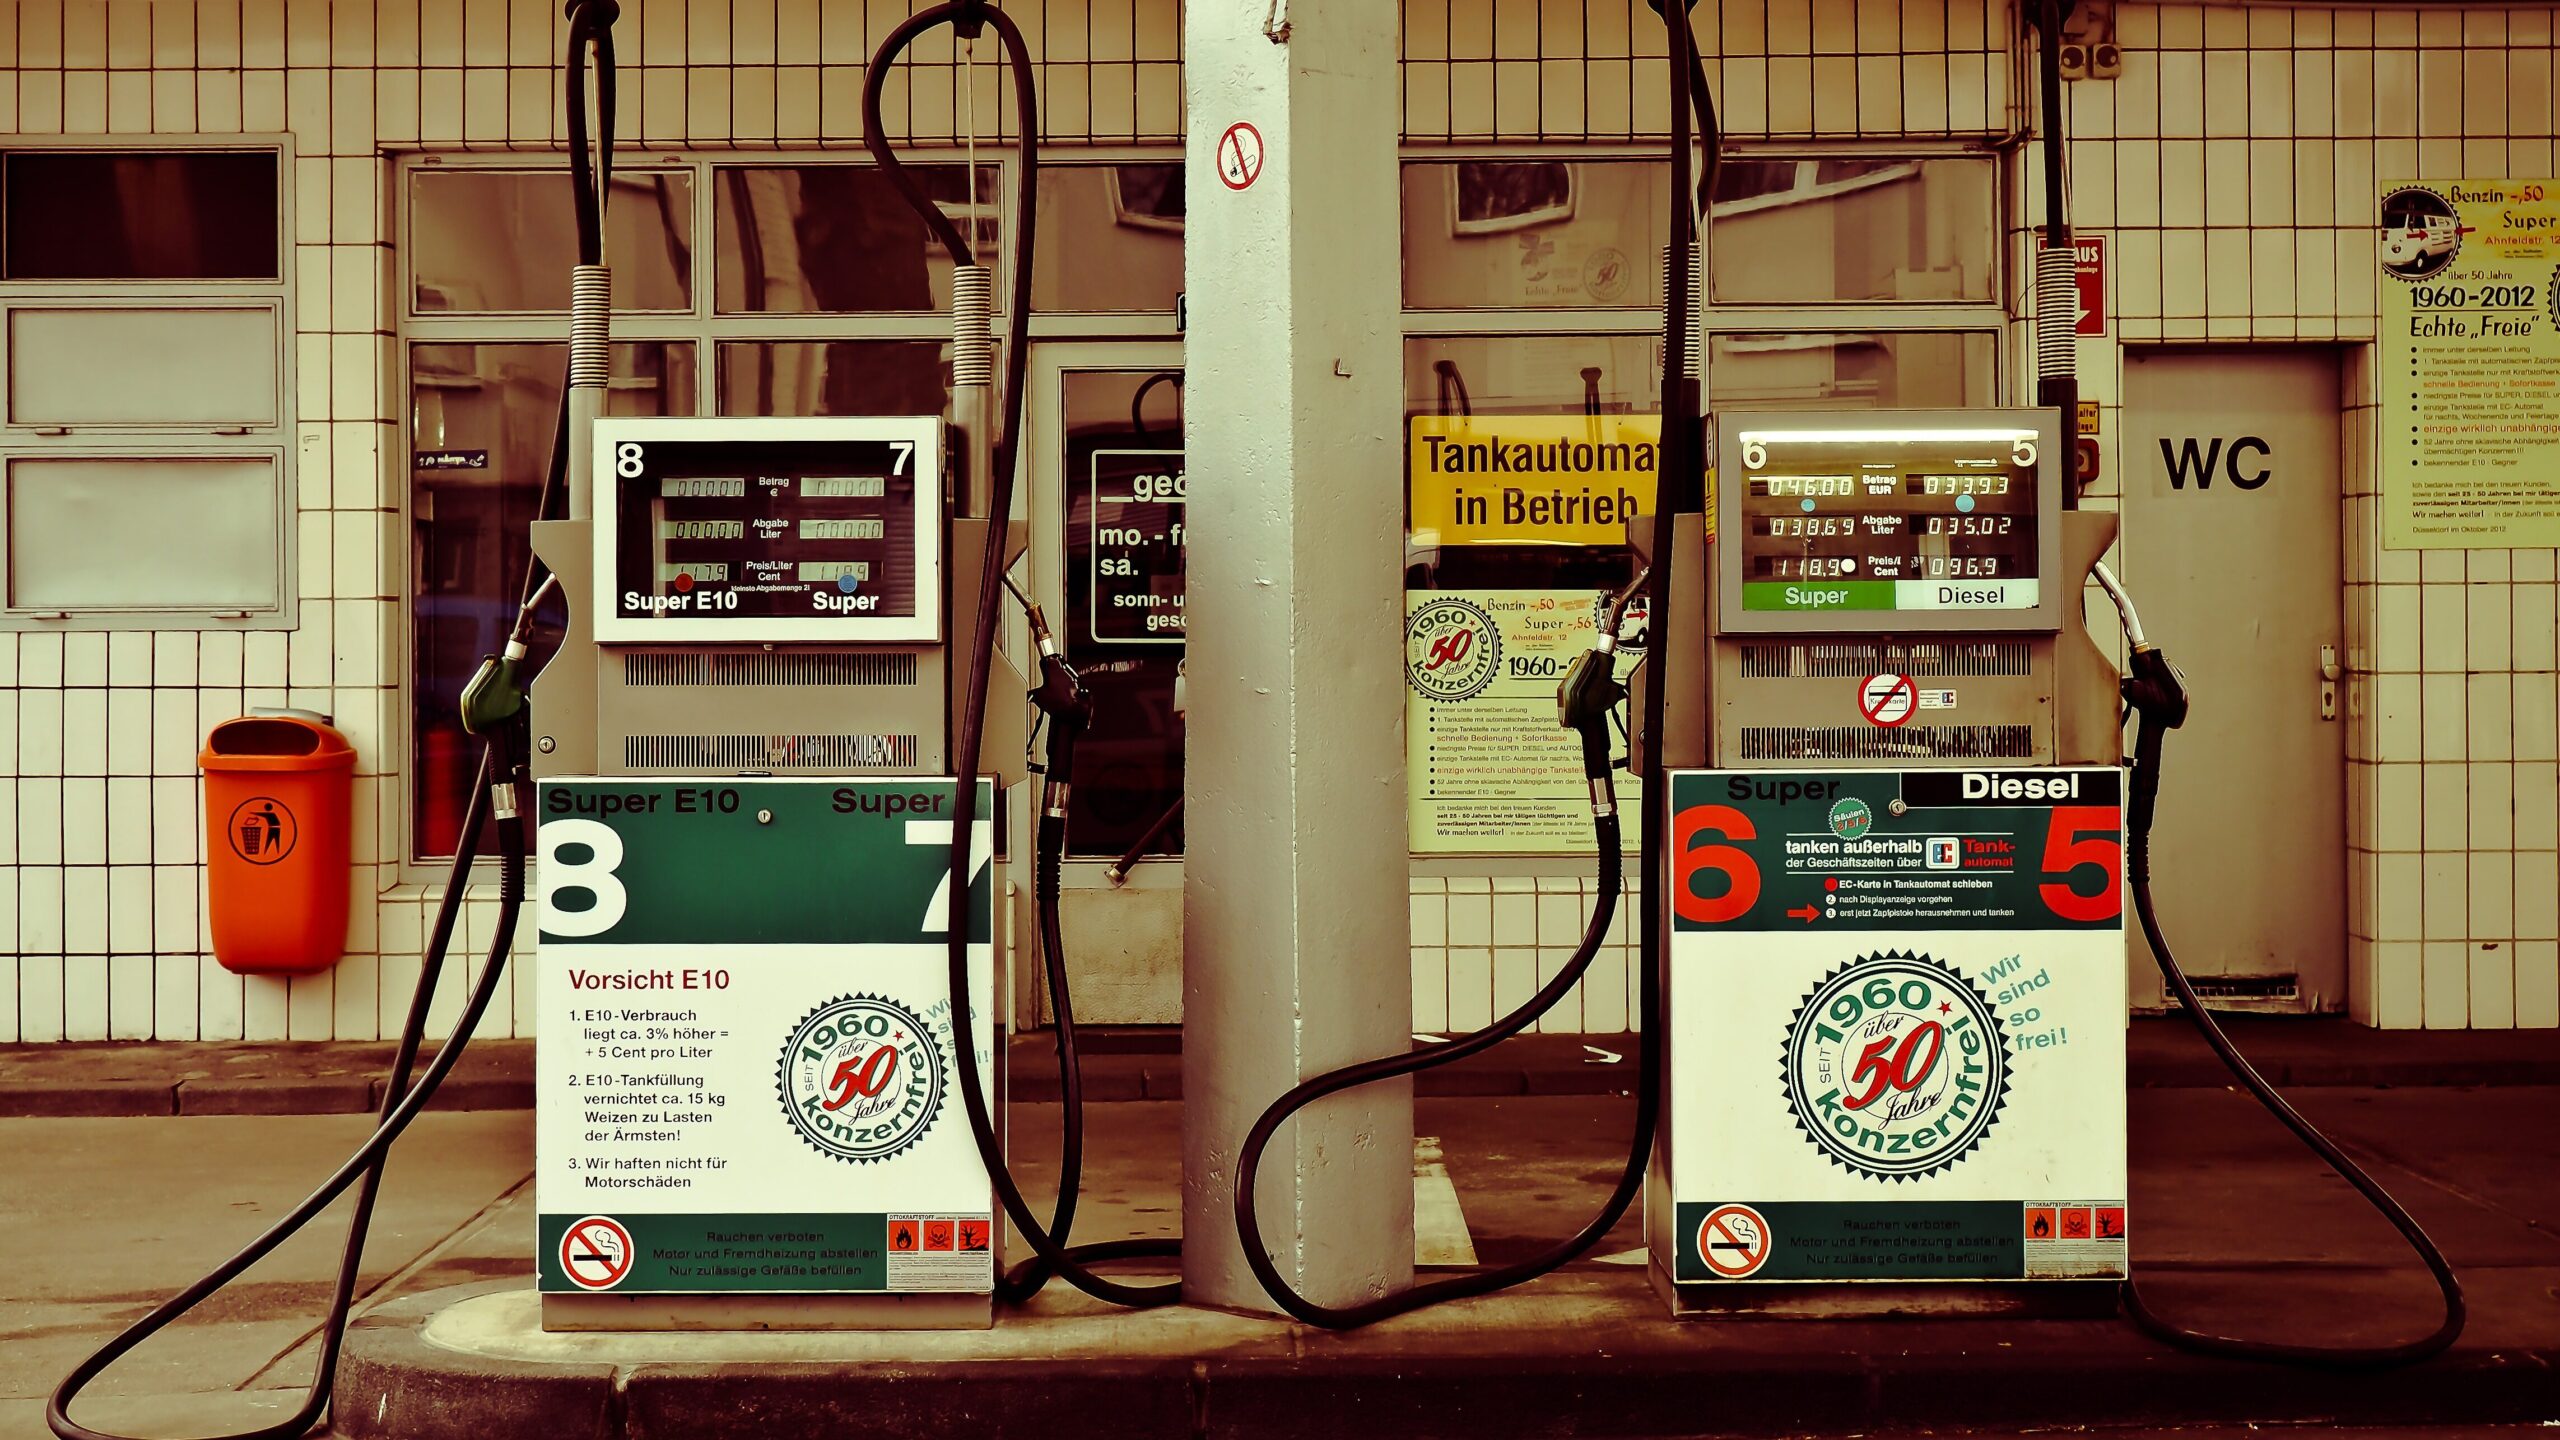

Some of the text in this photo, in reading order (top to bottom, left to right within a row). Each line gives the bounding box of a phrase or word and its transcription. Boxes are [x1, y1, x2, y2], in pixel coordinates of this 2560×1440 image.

[2450, 186, 2544, 205] Benzin -,50
[2504, 211, 2556, 230] Super
[2448, 271, 2512, 280] über 50 Jahre
[2410, 286, 2534, 307] 1960-2012
[2410, 316, 2466, 336] Echte
[617, 443, 644, 478] 8
[889, 442, 913, 475] 7
[1422, 436, 1661, 473] Tankautoma
[1742, 440, 1767, 470] 6
[2012, 439, 2037, 467] 5
[2159, 436, 2271, 490] WC
[759, 477, 789, 487] Betrag
[1862, 475, 1896, 486] Betrag
[1869, 486, 1892, 494] EUR
[1455, 487, 1638, 524] in Betrieb
[752, 519, 788, 529] Abgabe
[1862, 516, 1902, 526] Abgabe
[1872, 526, 1894, 534] Liter
[760, 530, 781, 538] Liter
[1100, 528, 1148, 546] mo.
[746, 562, 793, 572] Preis/Liter
[758, 572, 780, 581] Cent
[1100, 559, 1138, 576] sa.
[1874, 566, 1898, 576] Cent
[624, 591, 738, 613] Super E10
[813, 591, 879, 614] Super
[1114, 594, 1168, 606] sonn-
[1488, 598, 1526, 610] Benzin
[1530, 598, 1554, 612] -,50
[1785, 587, 1848, 608] Super
[1938, 586, 2004, 604] Diesel
[1412, 610, 1466, 640] 1960
[1524, 616, 1591, 630] Super -,56
[1413, 627, 1490, 690] konzernfrei
[1425, 630, 1472, 670] 50
[1508, 656, 1575, 676] 1960-
[1728, 776, 1840, 806] Super
[1963, 774, 2078, 799] Diesel
[548, 788, 740, 818] Super E10
[832, 788, 946, 818] Super
[1834, 809, 1864, 822] Säulen
[1437, 828, 1450, 836] Wir
[1786, 840, 1922, 854] tanken außerhalb
[1964, 840, 2015, 854] Tank-
[1673, 805, 1760, 922] 6
[1786, 856, 1922, 869] der Geschäftszeiten über
[1964, 856, 2014, 868] automat
[2039, 806, 2122, 920] 5
[538, 819, 627, 936] 8
[905, 820, 991, 932] 7
[1839, 880, 1993, 889] EC-Karte in Tankautomat schieben
[1860, 896, 1916, 905] Displayanzeige
[1918, 896, 1952, 905] vorgehen
[1856, 910, 1870, 918] jetzt
[569, 970, 729, 990] Vorsicht E10
[1980, 954, 2021, 986] Wir
[1998, 968, 2051, 1005] sind
[570, 1010, 581, 1021] 1.
[1815, 978, 1932, 1046] 1960
[2009, 1006, 2041, 1027] so
[1864, 1010, 1904, 1038] über
[584, 1028, 716, 1042] liegt ca. 3% höher
[802, 1014, 889, 1062] 1960
[2016, 1028, 2068, 1050] frei!
[598, 1046, 712, 1061] 5 Cent pro Liter
[838, 1039, 868, 1059] über
[1820, 1048, 1832, 1084] SEIT
[1842, 1020, 1945, 1111] 50
[568, 1075, 581, 1086] 2.
[804, 1065, 814, 1091] SEIT
[822, 1044, 900, 1111] 50
[1815, 1016, 1983, 1154] konzernfrei
[584, 1093, 726, 1108] vernichtet ca. 15 kg
[802, 1042, 925, 1143] konzernfrei
[585, 1111, 712, 1124] Weizen zu Lasten
[850, 1094, 896, 1124] Jahre
[1878, 1086, 1941, 1130] Jahre
[585, 1127, 681, 1142] der Ärmsten!
[568, 1157, 728, 1170] 3. Wir haften nicht für
[585, 1176, 691, 1188] Motorschäden
[707, 1232, 824, 1242] Rauchen verboten
[653, 1249, 878, 1260] Motor und Fremdheizung abstellen
[670, 1265, 862, 1278] Nur zulässige Gefäße befüllen
